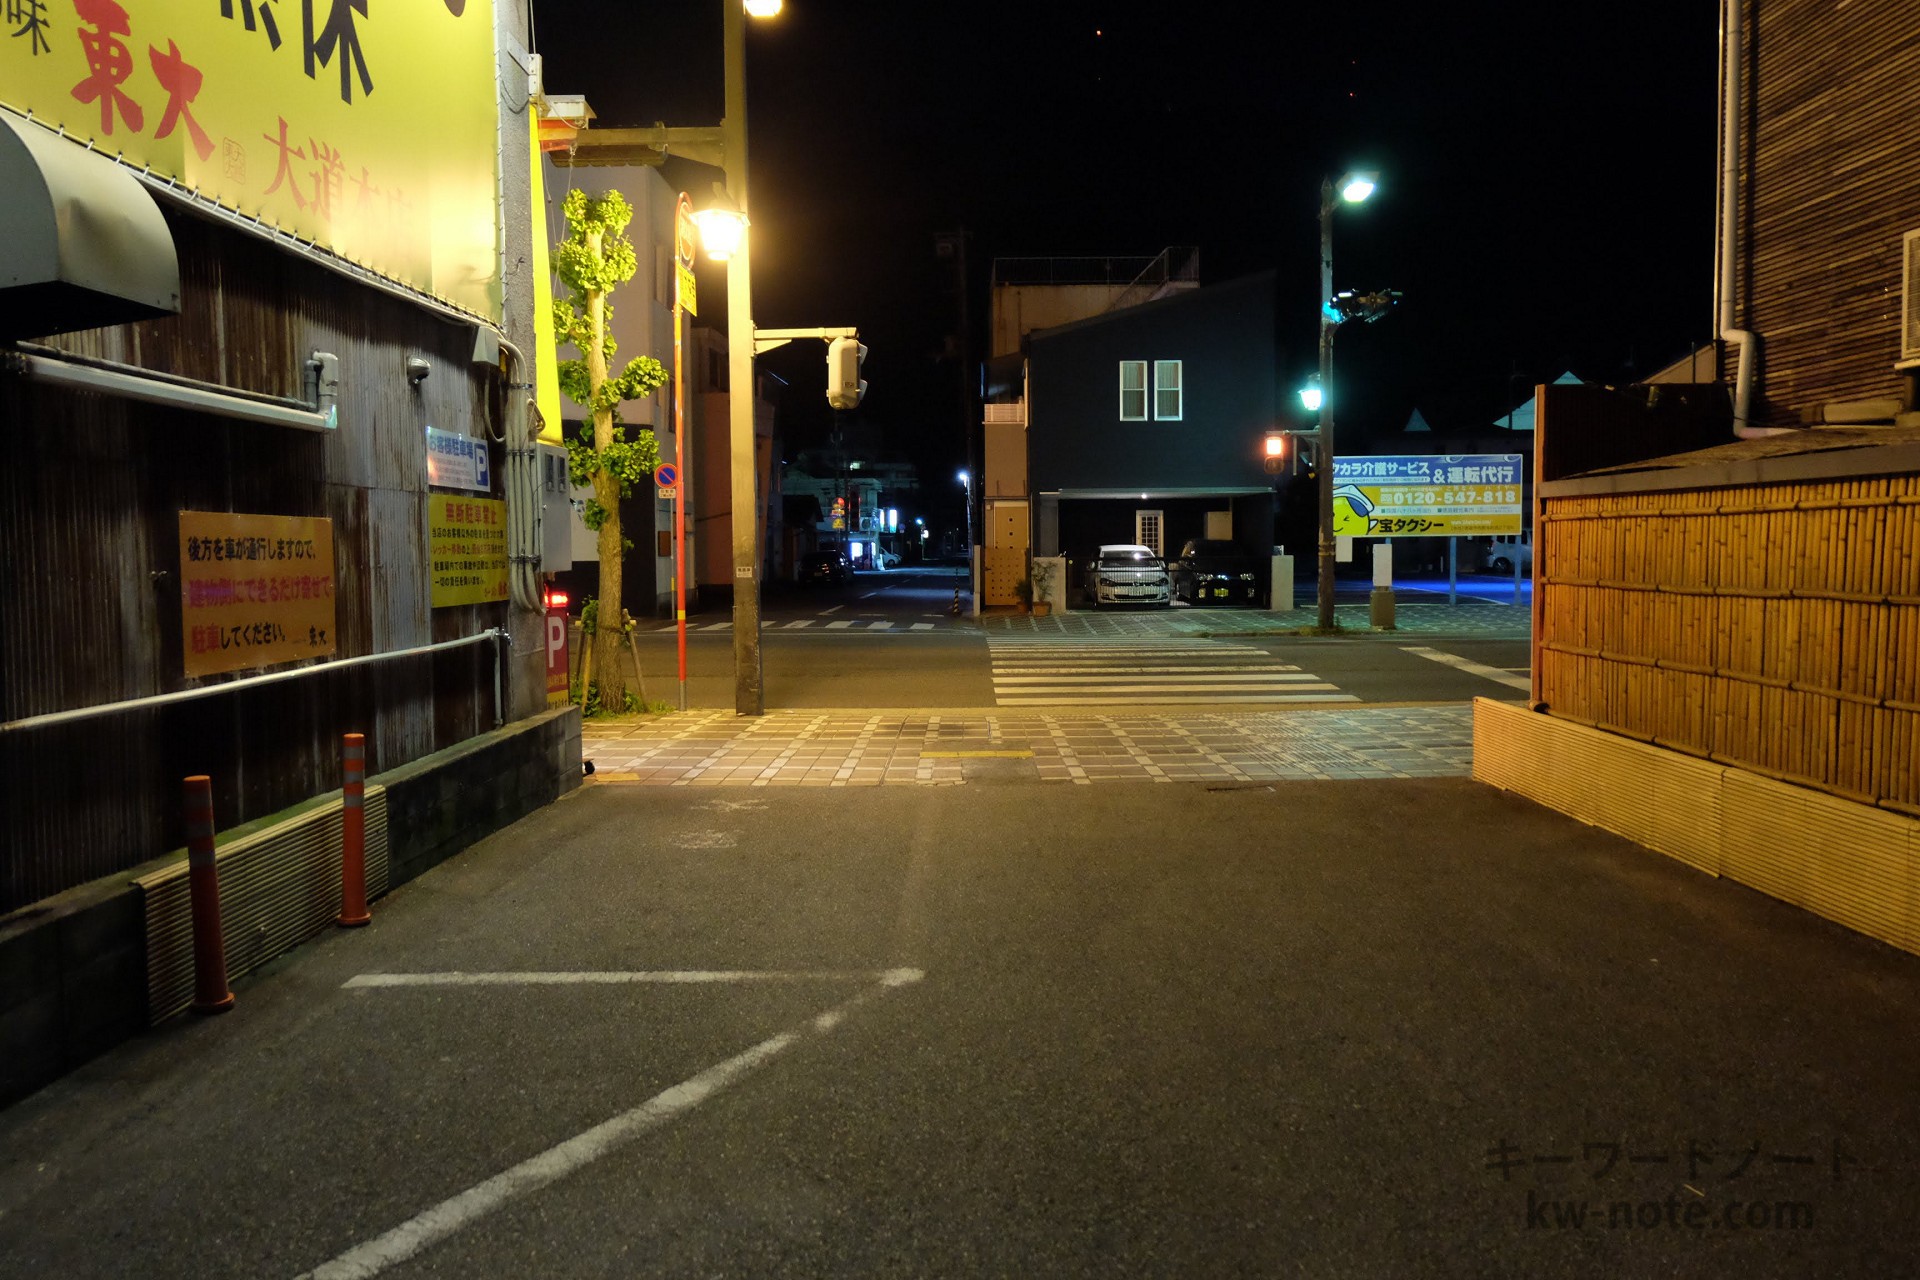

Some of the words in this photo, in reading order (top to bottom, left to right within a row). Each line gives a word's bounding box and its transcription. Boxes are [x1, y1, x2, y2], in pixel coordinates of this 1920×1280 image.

[70, 0, 215, 161] 東大
[475, 447, 488, 482] P
[1447, 466, 1514, 483] 運転代行
[1393, 491, 1516, 505] 0120-547-818
[1379, 518, 1444, 533] 宝タクシー
[187, 536, 316, 561] 後方を車が通行しますので、
[547, 616, 565, 668] P
